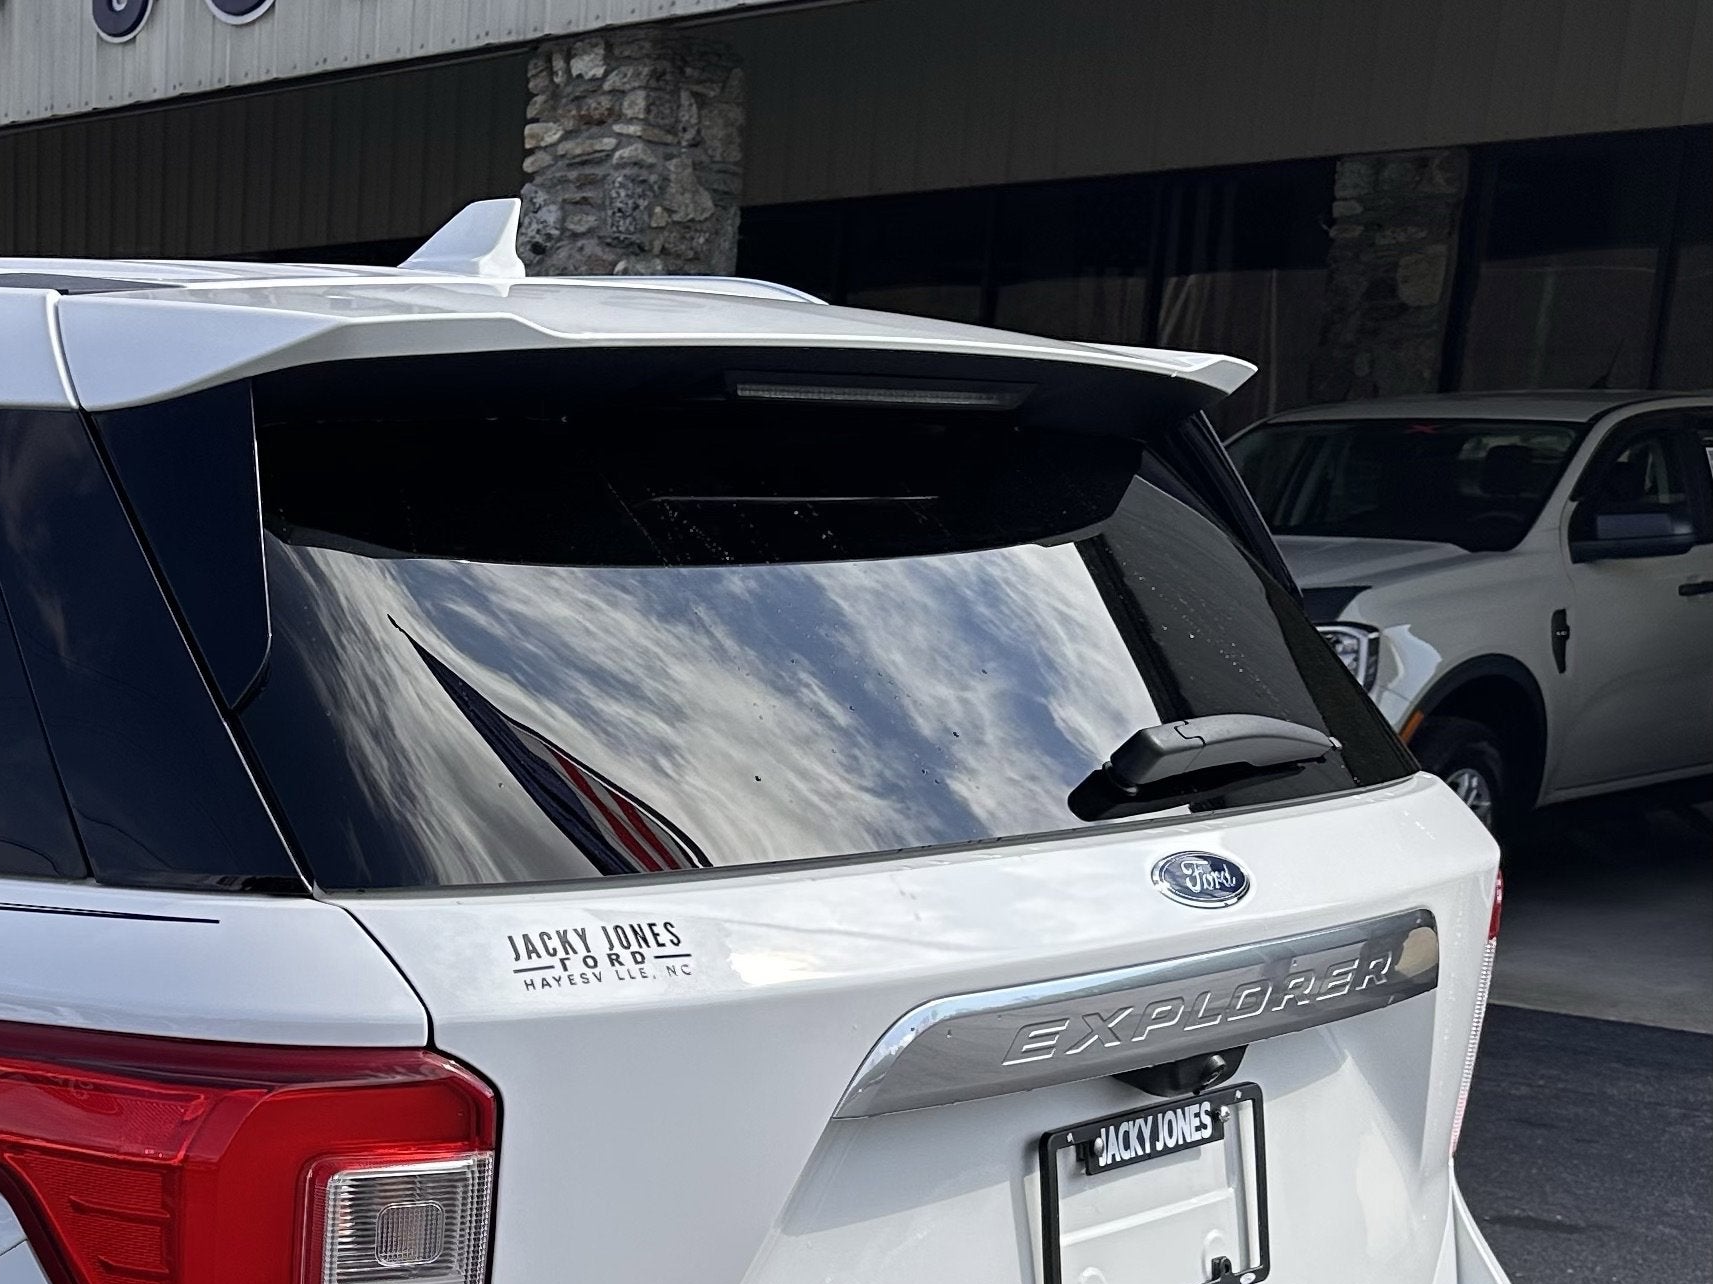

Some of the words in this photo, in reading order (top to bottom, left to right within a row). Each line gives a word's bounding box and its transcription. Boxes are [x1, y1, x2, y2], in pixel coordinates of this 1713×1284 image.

[1180, 860, 1237, 893] Ford
[506, 926, 592, 962] JACKY
[600, 920, 682, 952] JONES
[523, 966, 657, 992] HAYESVLLE,
[665, 963, 693, 978] NC
[1000, 950, 1394, 1067] EXPLORER
[1098, 1115, 1154, 1168] JACKY
[1155, 1101, 1213, 1152] JONES
